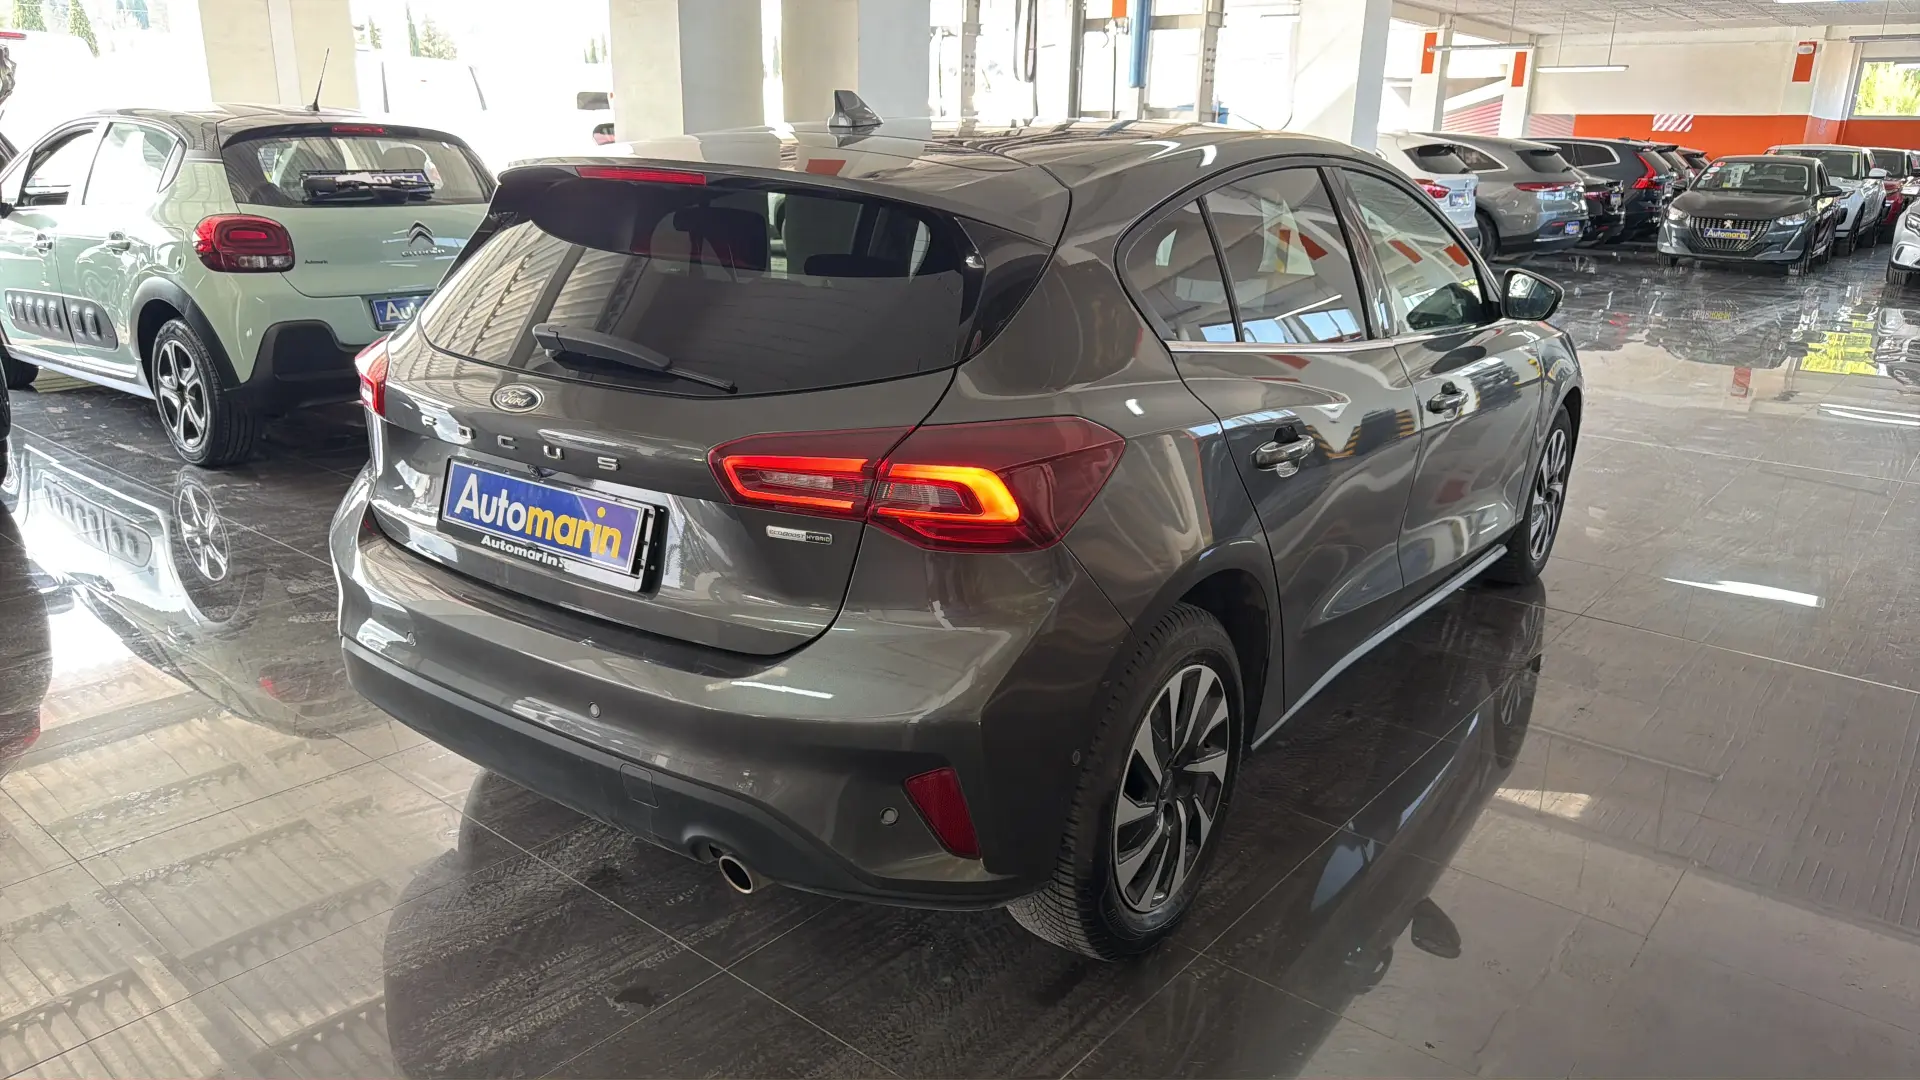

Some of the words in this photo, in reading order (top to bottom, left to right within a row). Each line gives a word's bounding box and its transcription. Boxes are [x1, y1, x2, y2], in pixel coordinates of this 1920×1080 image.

[421, 415, 620, 471] FOCUS
[454, 473, 621, 558] Automarin
[806, 534, 830, 542] HYBRID
